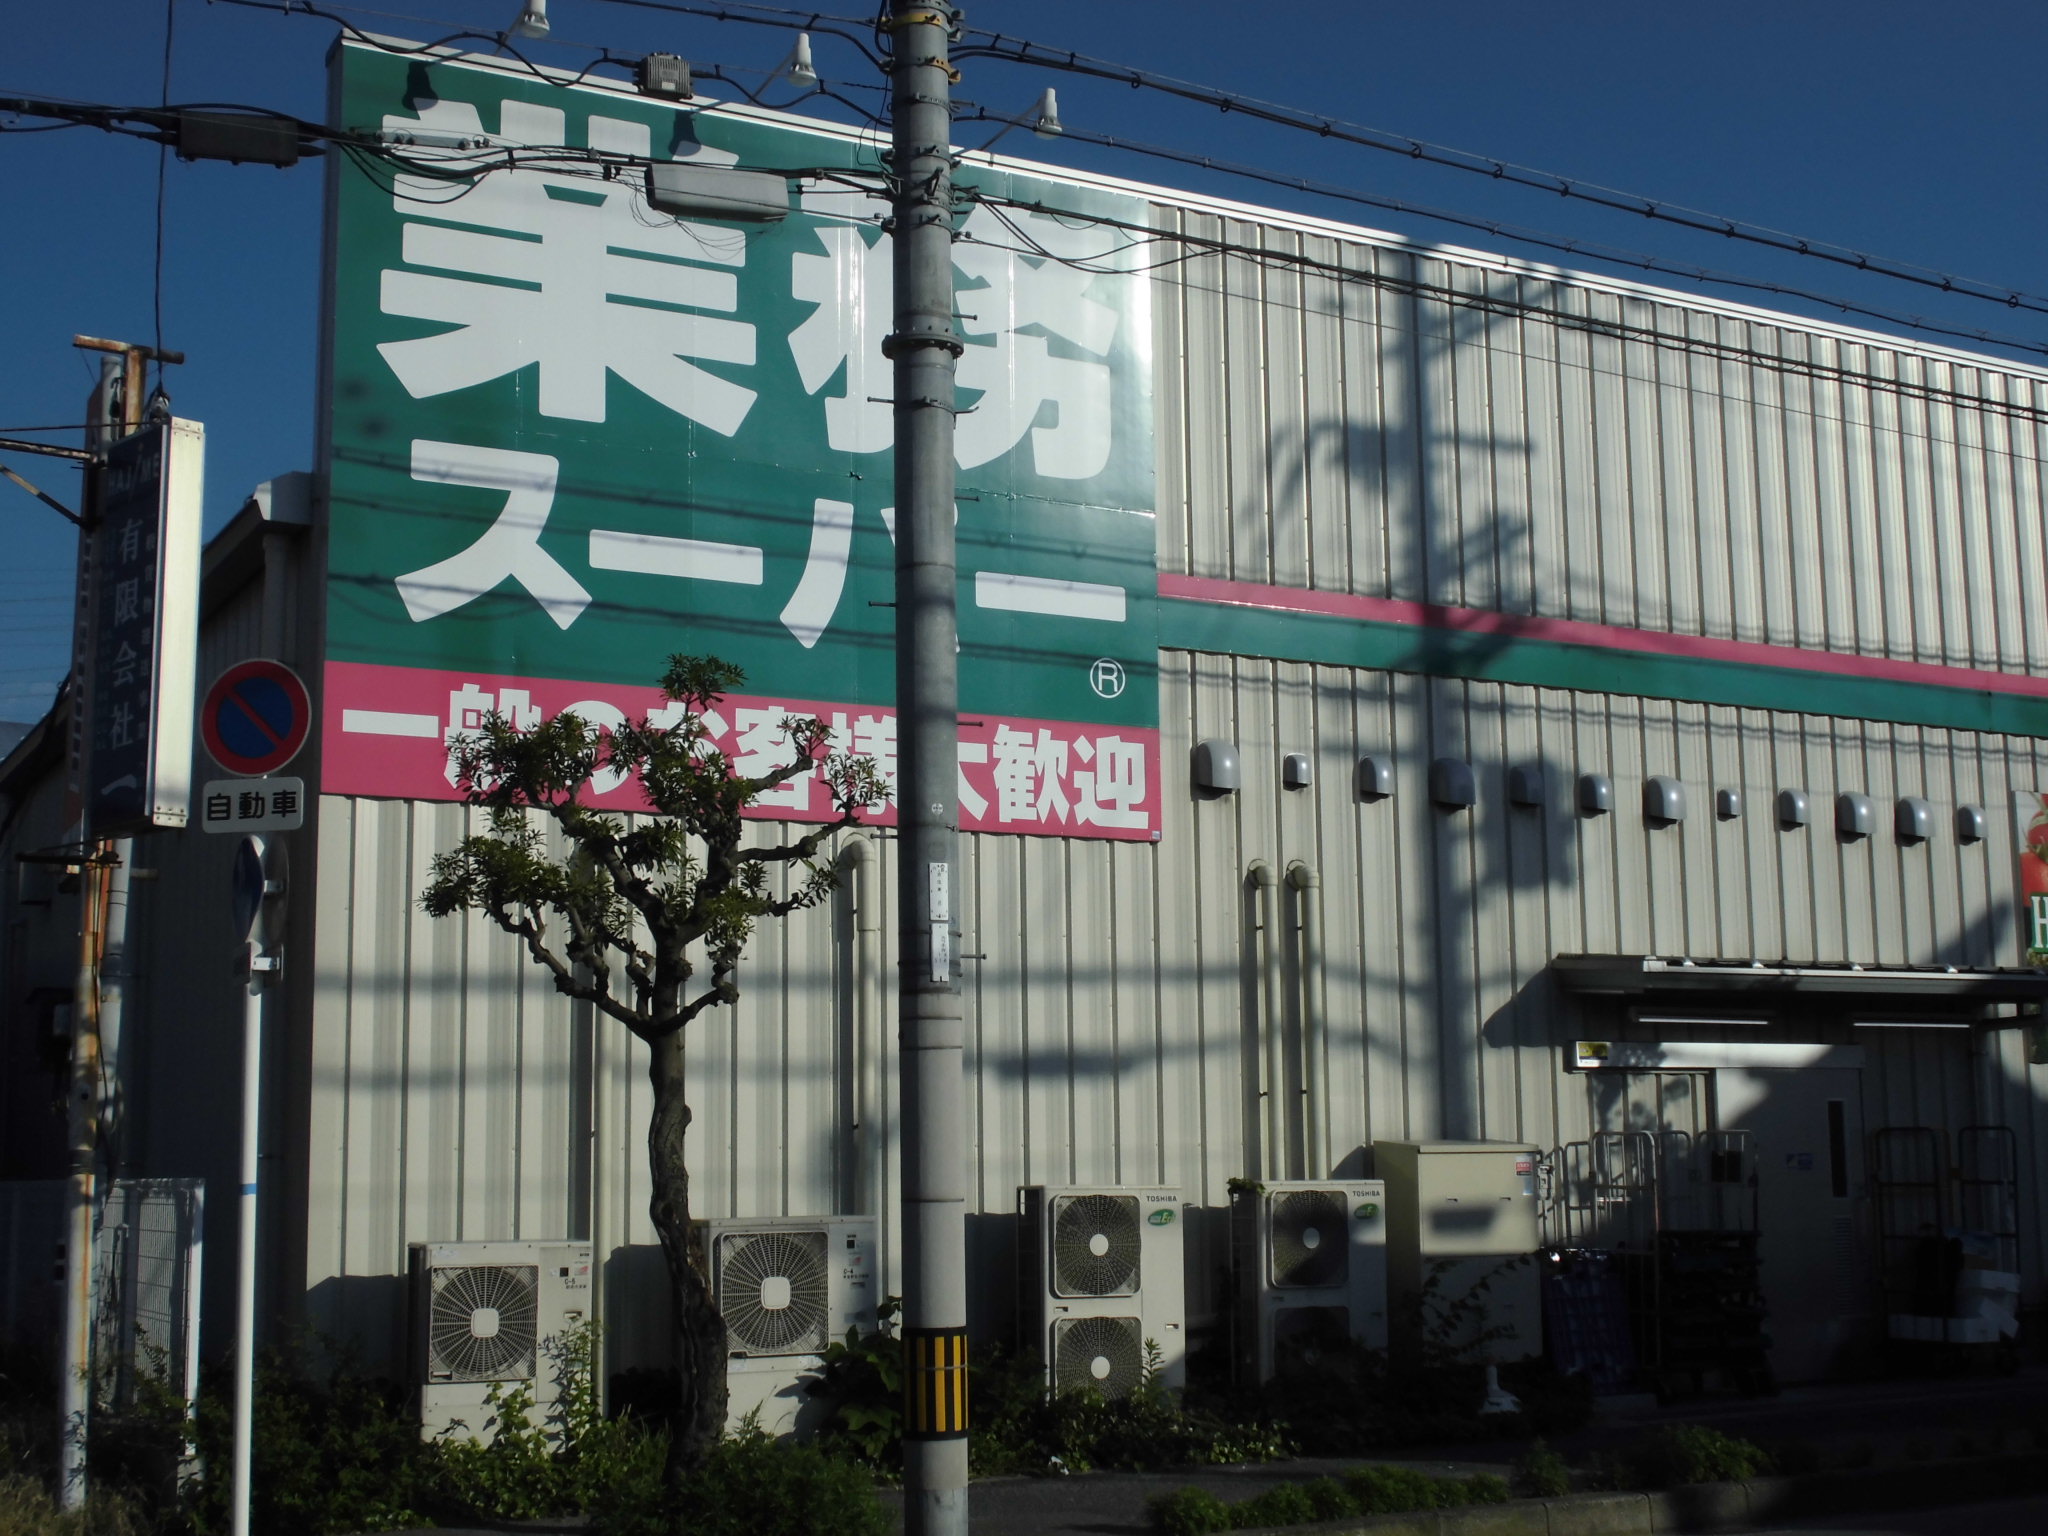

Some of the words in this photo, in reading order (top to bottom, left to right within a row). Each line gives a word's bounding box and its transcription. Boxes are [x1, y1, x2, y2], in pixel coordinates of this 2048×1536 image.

[377, 99, 1119, 479] 業務
[207, 789, 298, 821] 自動車
